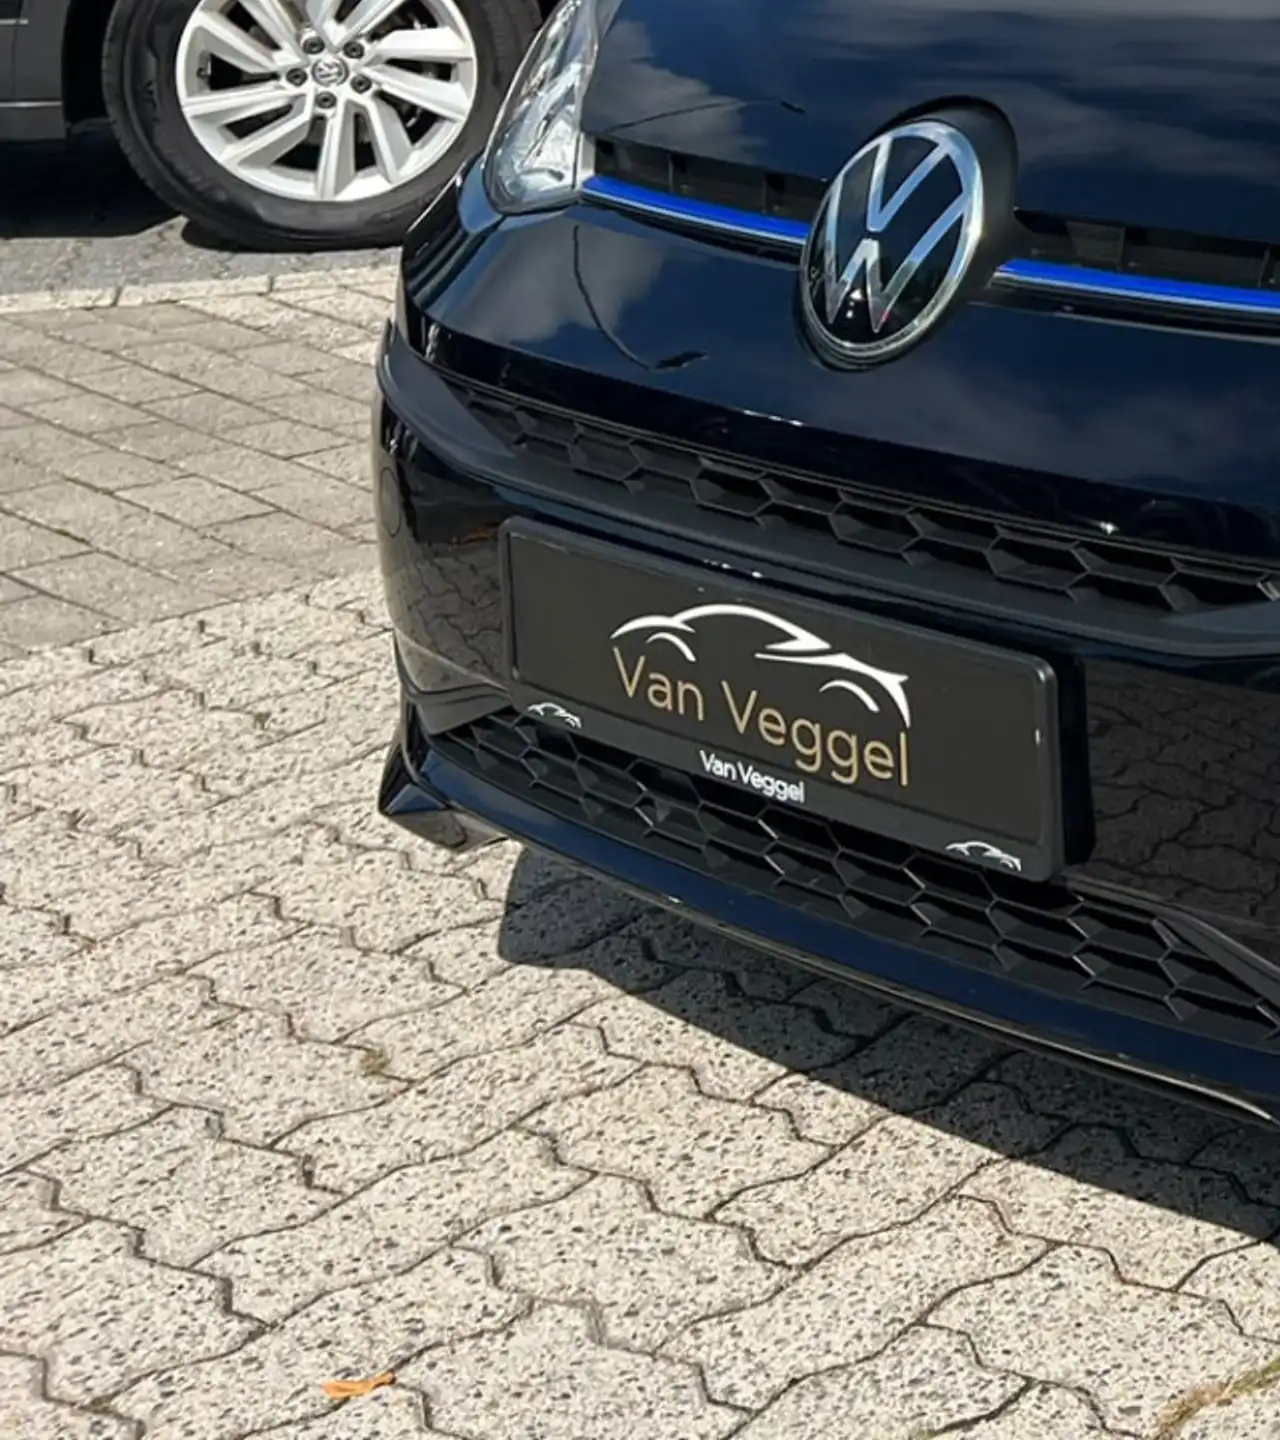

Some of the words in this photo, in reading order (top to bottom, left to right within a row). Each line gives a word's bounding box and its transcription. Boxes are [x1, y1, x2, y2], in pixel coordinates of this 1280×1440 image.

[612, 647, 705, 722] Van
[721, 680, 909, 788] Veggel
[699, 749, 737, 781] Van
[737, 761, 805, 804] Veggel
